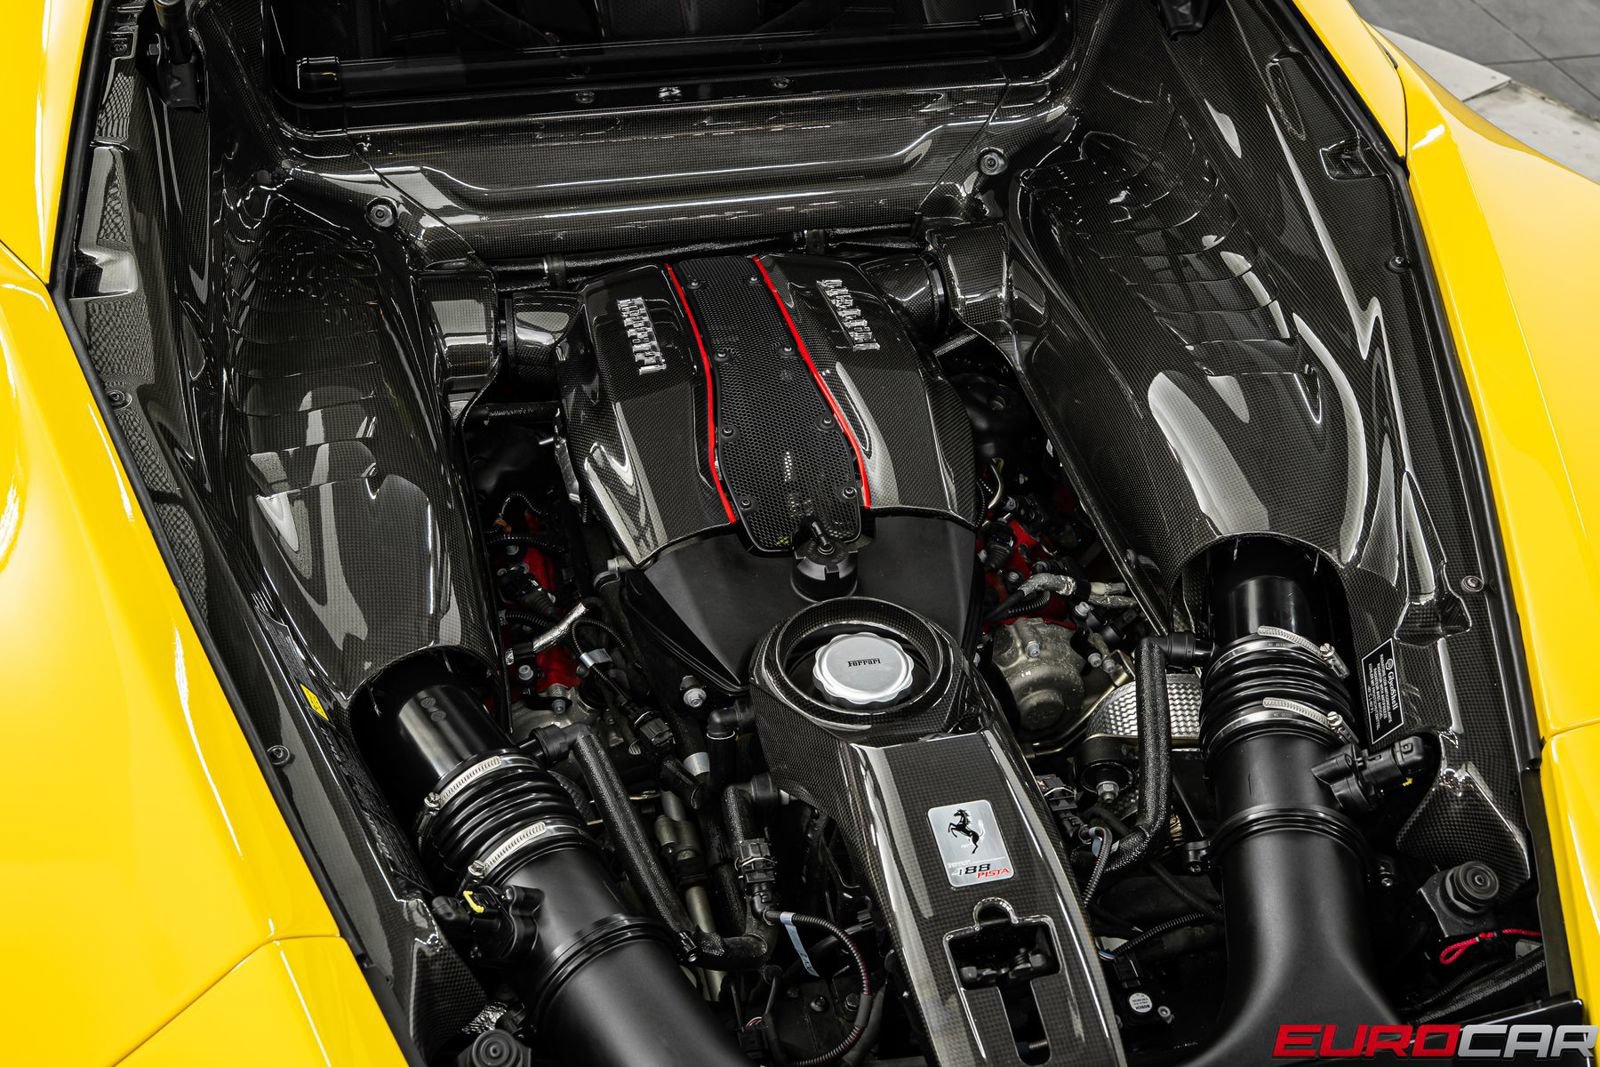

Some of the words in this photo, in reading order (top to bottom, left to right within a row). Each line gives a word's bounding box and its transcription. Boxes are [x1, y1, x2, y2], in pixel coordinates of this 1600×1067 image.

[848, 658, 881, 667] Ferrari
[1388, 671, 1398, 710] GlycoShell
[977, 867, 1009, 879] PISTA
